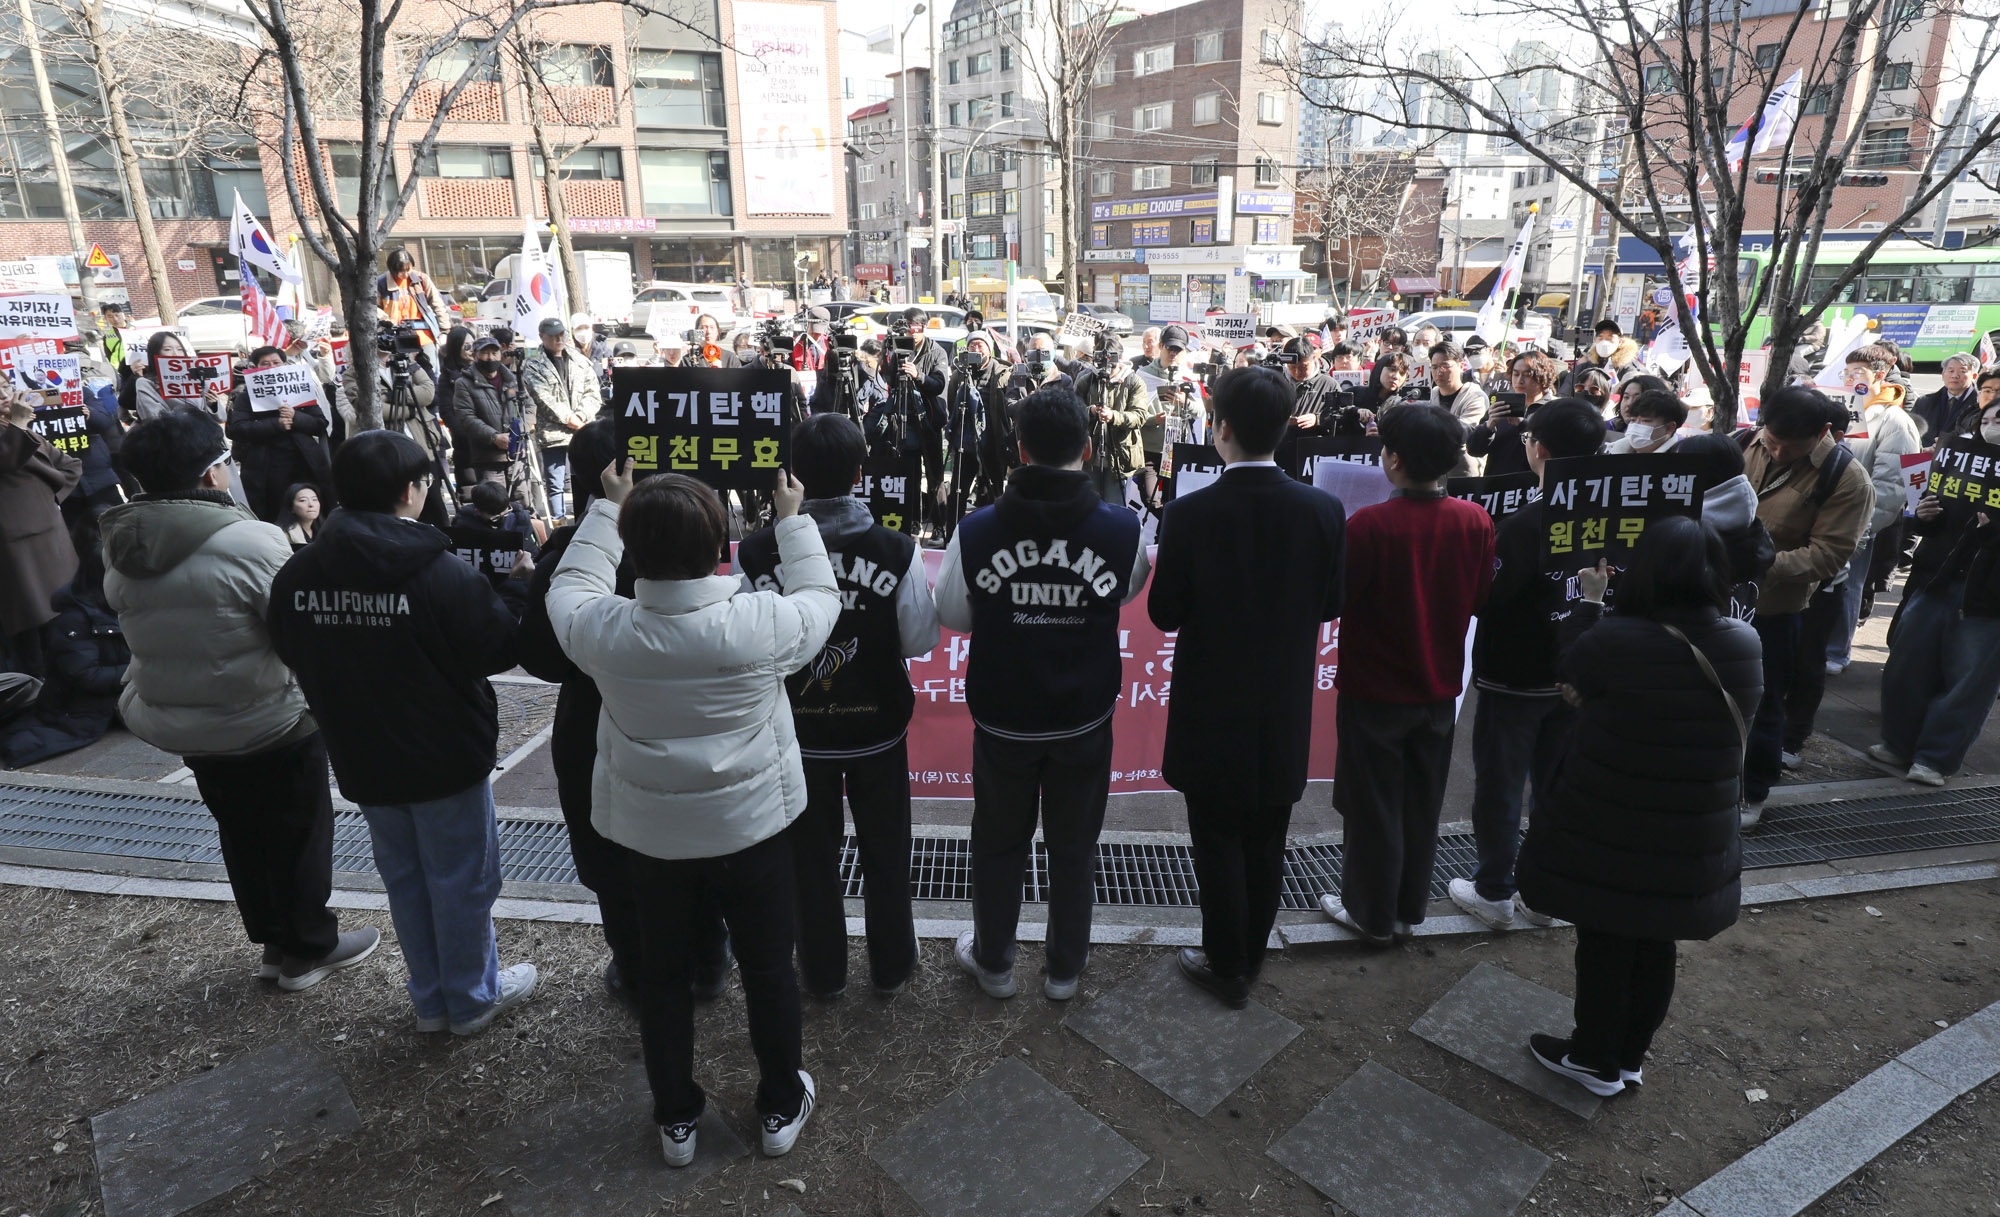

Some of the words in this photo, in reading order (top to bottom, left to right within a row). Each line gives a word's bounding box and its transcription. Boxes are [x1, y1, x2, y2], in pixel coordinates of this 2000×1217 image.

[8, 300, 60, 315] 지키자!
[1067, 313, 1106, 330] 부정선거
[1215, 318, 1249, 329] 지키자!
[1351, 311, 1395, 330] 부정선거
[1206, 328, 1254, 340] 자유대한민국
[37, 358, 78, 369] FREEDOM
[168, 357, 222, 373] STOP
[66, 379, 80, 390] NOT
[252, 370, 306, 386] 척결하자!
[62, 391, 82, 406] REE
[252, 382, 311, 399] 반국가세력
[625, 390, 783, 426] 사기탄핵
[31, 415, 87, 436] 사기탄핵
[53, 434, 90, 454] 천무효
[627, 435, 783, 470] 원천무효
[850, 475, 907, 504] 탄핵
[1550, 474, 1697, 511] 사기탄핵
[1549, 517, 1645, 554] 원천무
[754, 551, 898, 598] SANG
[975, 538, 1118, 598] SOGANG
[294, 590, 411, 616] CALIFORNIA
[1010, 582, 1089, 608] UNIV.
[366, 615, 392, 627] 1849
[1012, 611, 1086, 625] Mathematics
[791, 702, 825, 716] lectronic
[828, 702, 880, 717] Engineering
